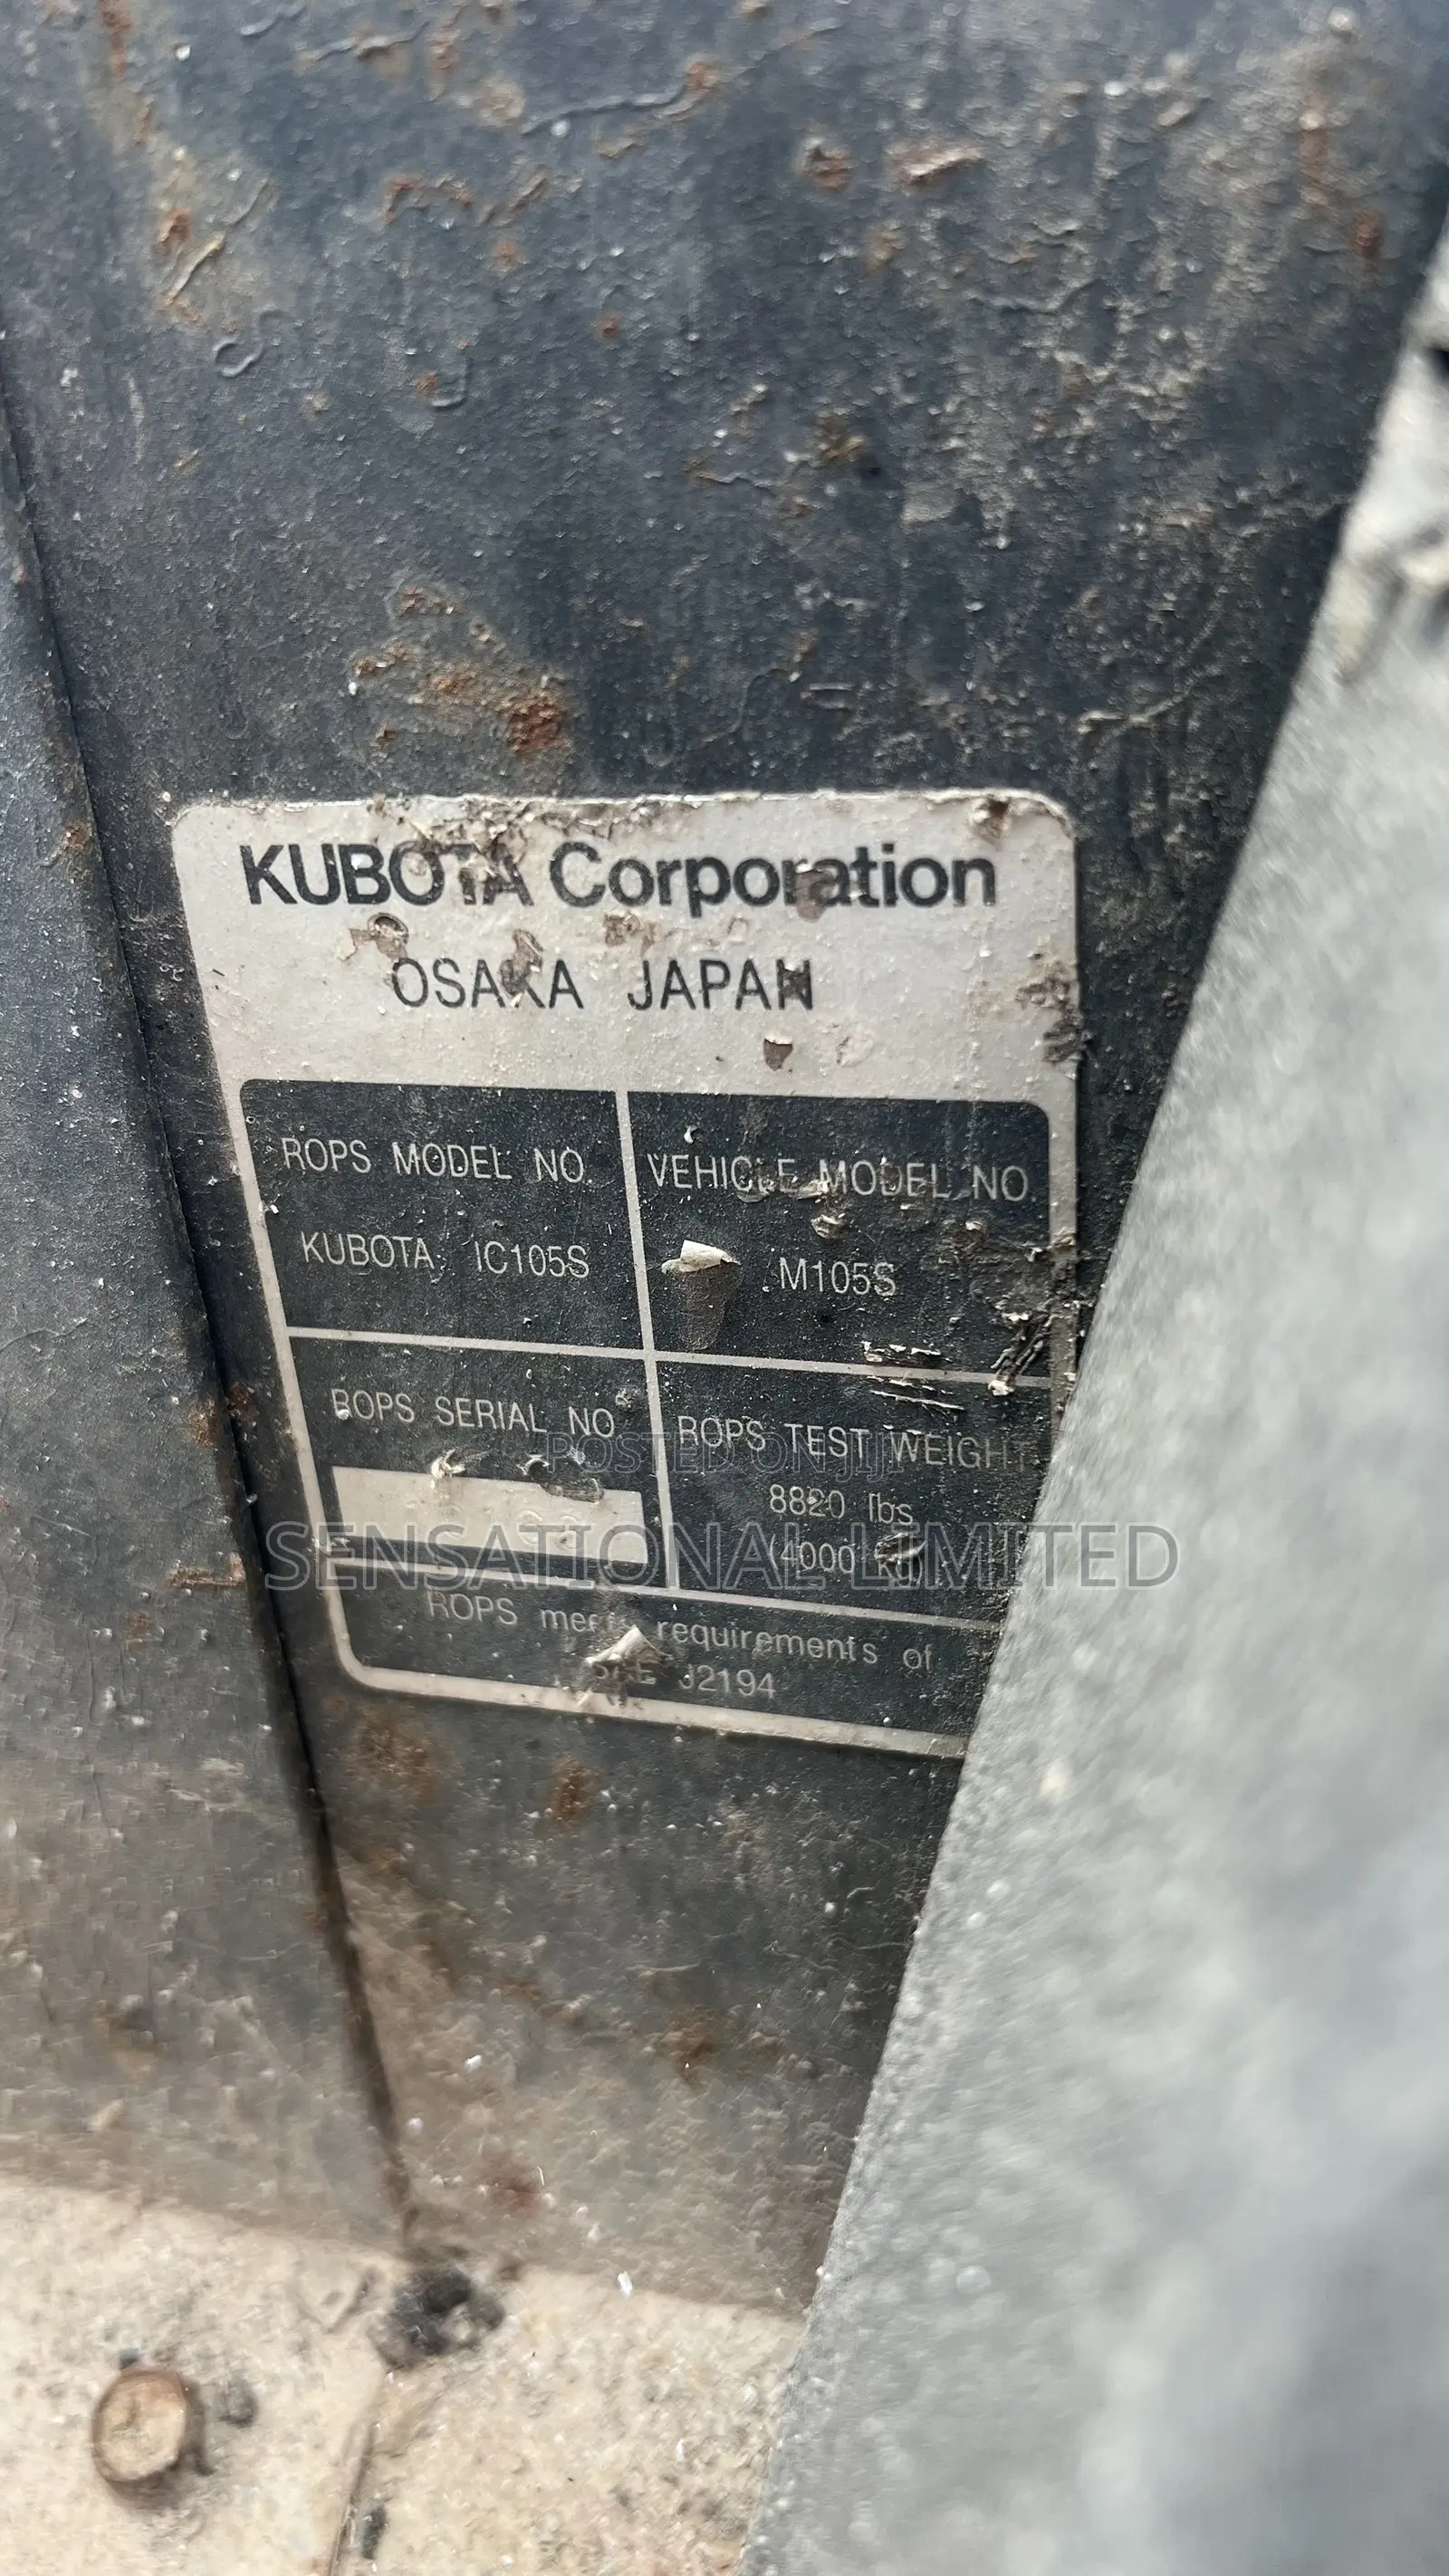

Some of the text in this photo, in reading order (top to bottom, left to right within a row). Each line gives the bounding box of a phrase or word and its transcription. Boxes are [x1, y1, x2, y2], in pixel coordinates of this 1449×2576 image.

[239, 839, 996, 918] KUBOTA Corporation
[391, 957, 814, 1011] OSAKA JAPAN
[281, 1137, 372, 1174] ROPS
[392, 1142, 513, 1180] MODEL
[646, 1153, 797, 1194] VEHICLE
[818, 1158, 952, 1200] MODEL
[300, 1231, 590, 1279] KUBOTA IC105S
[779, 1257, 897, 1298] M105S
[331, 1388, 416, 1423] ROPS
[434, 1395, 548, 1433] SERIAL
[677, 1414, 1034, 1473] ROPS TEST WEIGHT
[769, 1483, 914, 1527] 8820 lbs
[769, 1533, 856, 1575] (4000
[427, 1591, 518, 1626] ROPS
[656, 1618, 878, 1666] requirements
[902, 1644, 934, 1672] of
[678, 1662, 776, 1700] J2194
